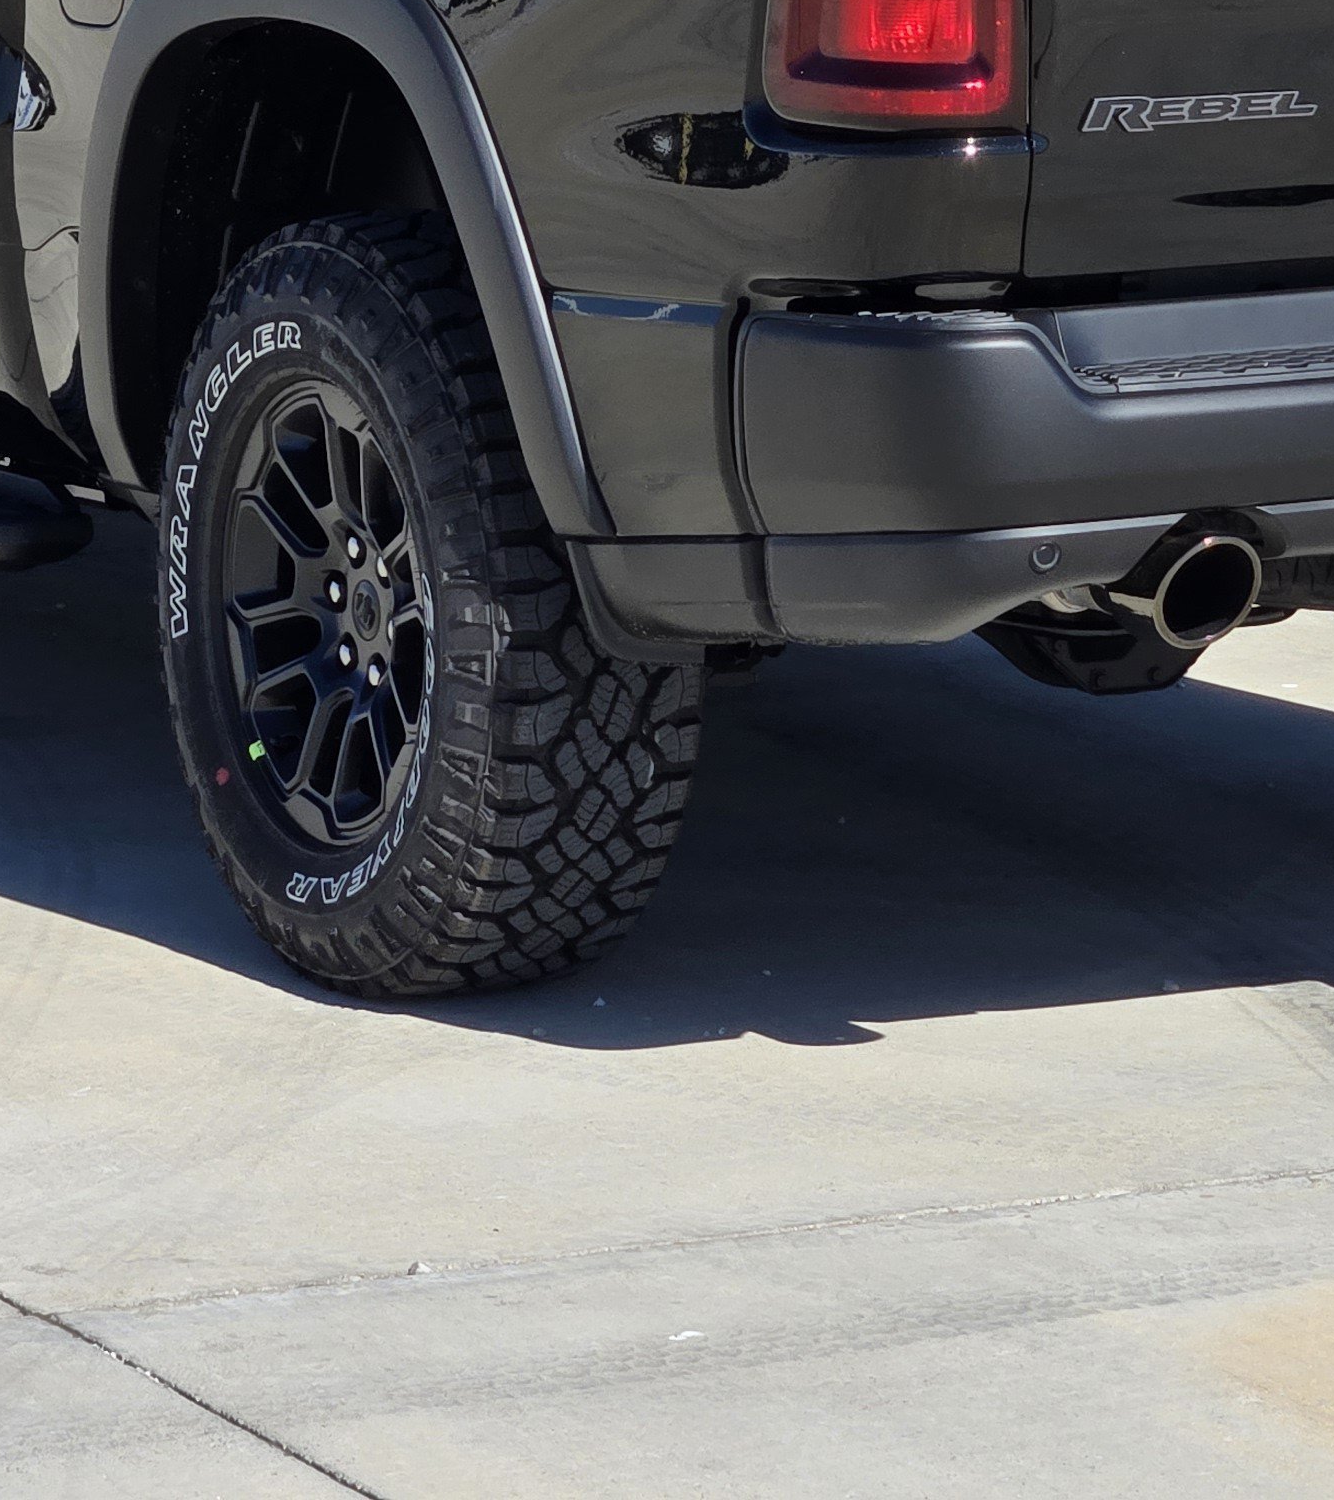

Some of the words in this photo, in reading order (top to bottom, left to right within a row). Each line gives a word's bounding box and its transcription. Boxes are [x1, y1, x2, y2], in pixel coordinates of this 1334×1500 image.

[1081, 91, 1318, 132] REBEL
[169, 321, 302, 638] WRANGLER
[286, 572, 435, 903] GOODYEAR
